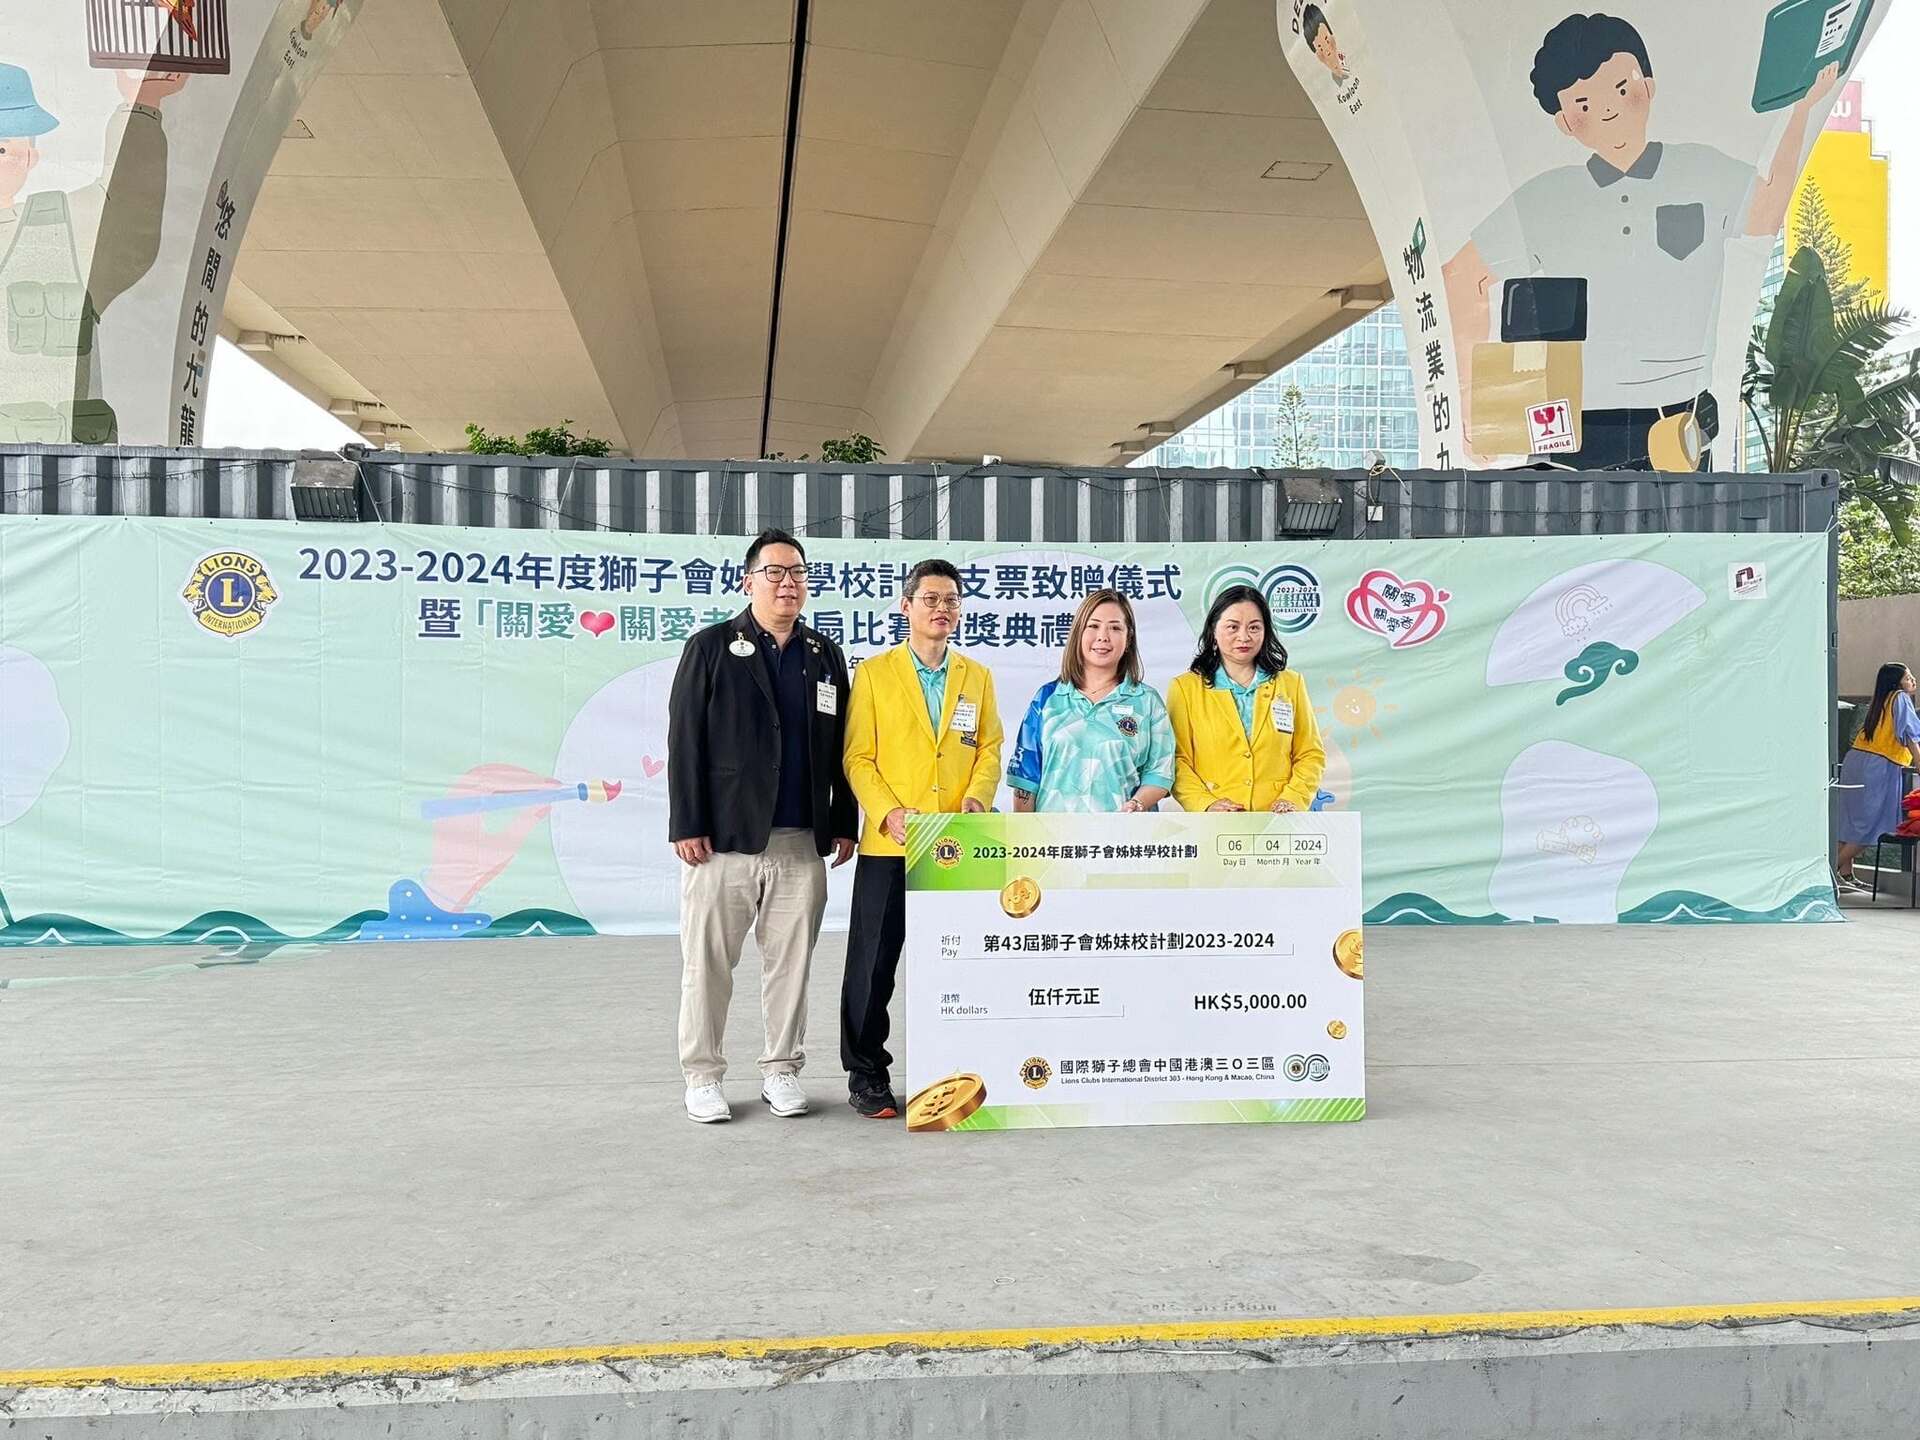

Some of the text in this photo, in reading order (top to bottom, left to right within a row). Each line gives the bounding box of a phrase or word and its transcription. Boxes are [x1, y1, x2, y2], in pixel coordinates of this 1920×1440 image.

[288, 27, 308, 58] Kowloon
[283, 50, 296, 71] East
[1336, 77, 1360, 104] Kowloon
[1349, 99, 1363, 115] East
[1538, 440, 1571, 452] FRAGILE
[204, 555, 258, 574] LIONS
[220, 578, 244, 607] L
[1276, 586, 1318, 594] 2023-2024
[1382, 583, 1416, 608] 關愛
[203, 613, 257, 630] INTERNATIONAL
[1373, 607, 1414, 632] 關愛者
[973, 845, 1198, 860] 2023-2024年度獅子會姊妹學校計劃
[1228, 840, 1322, 851] 06 04 2024
[1223, 858, 1246, 867] Day 日
[1257, 858, 1290, 866] Month 月
[1295, 858, 1312, 866] Year
[984, 933, 1275, 953] 第43屆獅子會姊妹校計劃2023-2024
[941, 947, 957, 958] Pay
[940, 993, 960, 1004] 港幣
[1028, 987, 1101, 1007] 伍仟元正
[1194, 993, 1307, 1013] HK$5,000.00
[940, 1005, 989, 1015] HK dollars
[1061, 1077, 1080, 1085] Lions
[1186, 1074, 1204, 1083] Hong
[1205, 1074, 1223, 1083] Kong
[1231, 1073, 1254, 1082] Macao,
[1255, 1072, 1275, 1081] China
